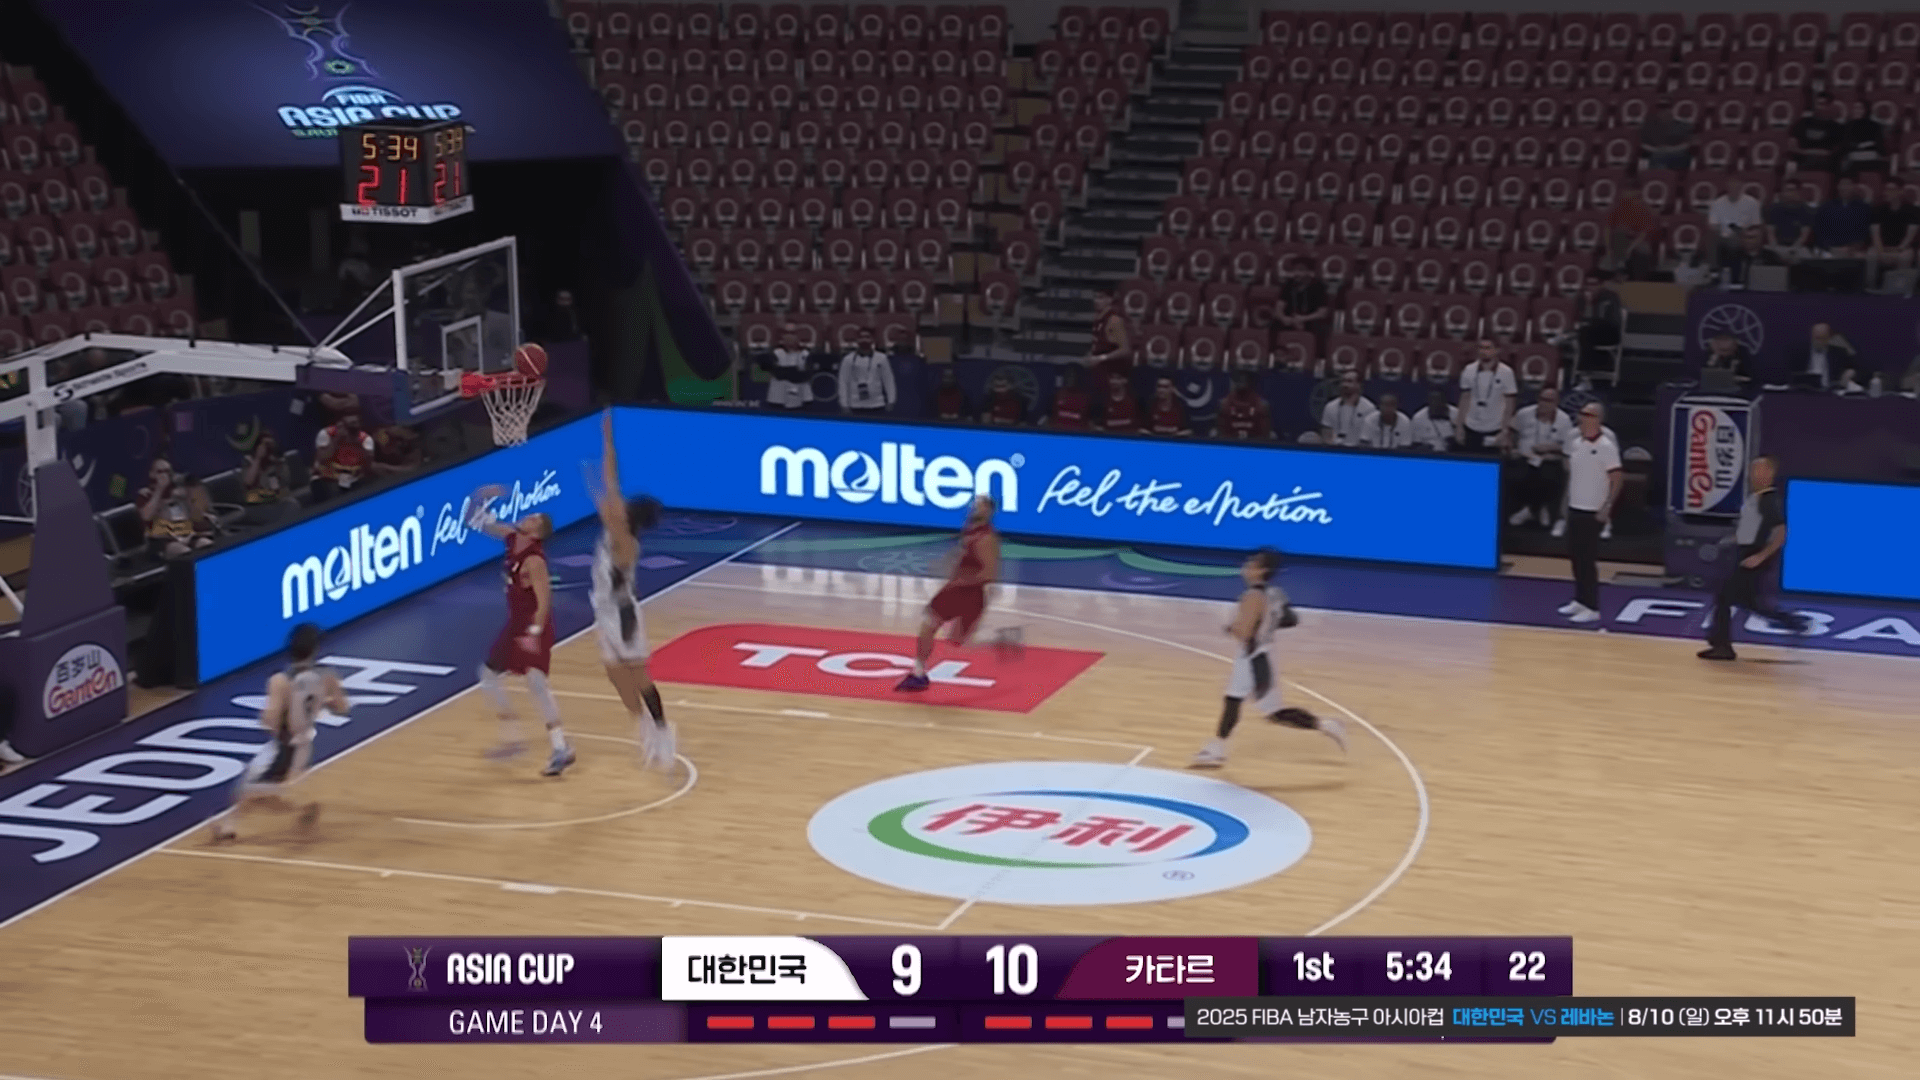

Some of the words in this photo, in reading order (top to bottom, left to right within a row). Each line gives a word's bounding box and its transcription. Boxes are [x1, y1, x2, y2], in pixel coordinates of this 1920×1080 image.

[278, 105, 376, 127] ASIA
[362, 133, 418, 160] 5:34
[357, 165, 407, 207] 21
[373, 207, 418, 218] TISSOT
[761, 442, 1018, 512] molten
[1116, 479, 1183, 517] the
[282, 515, 423, 620] molten
[733, 641, 997, 688] TCL
[921, 803, 1195, 855] 伊利
